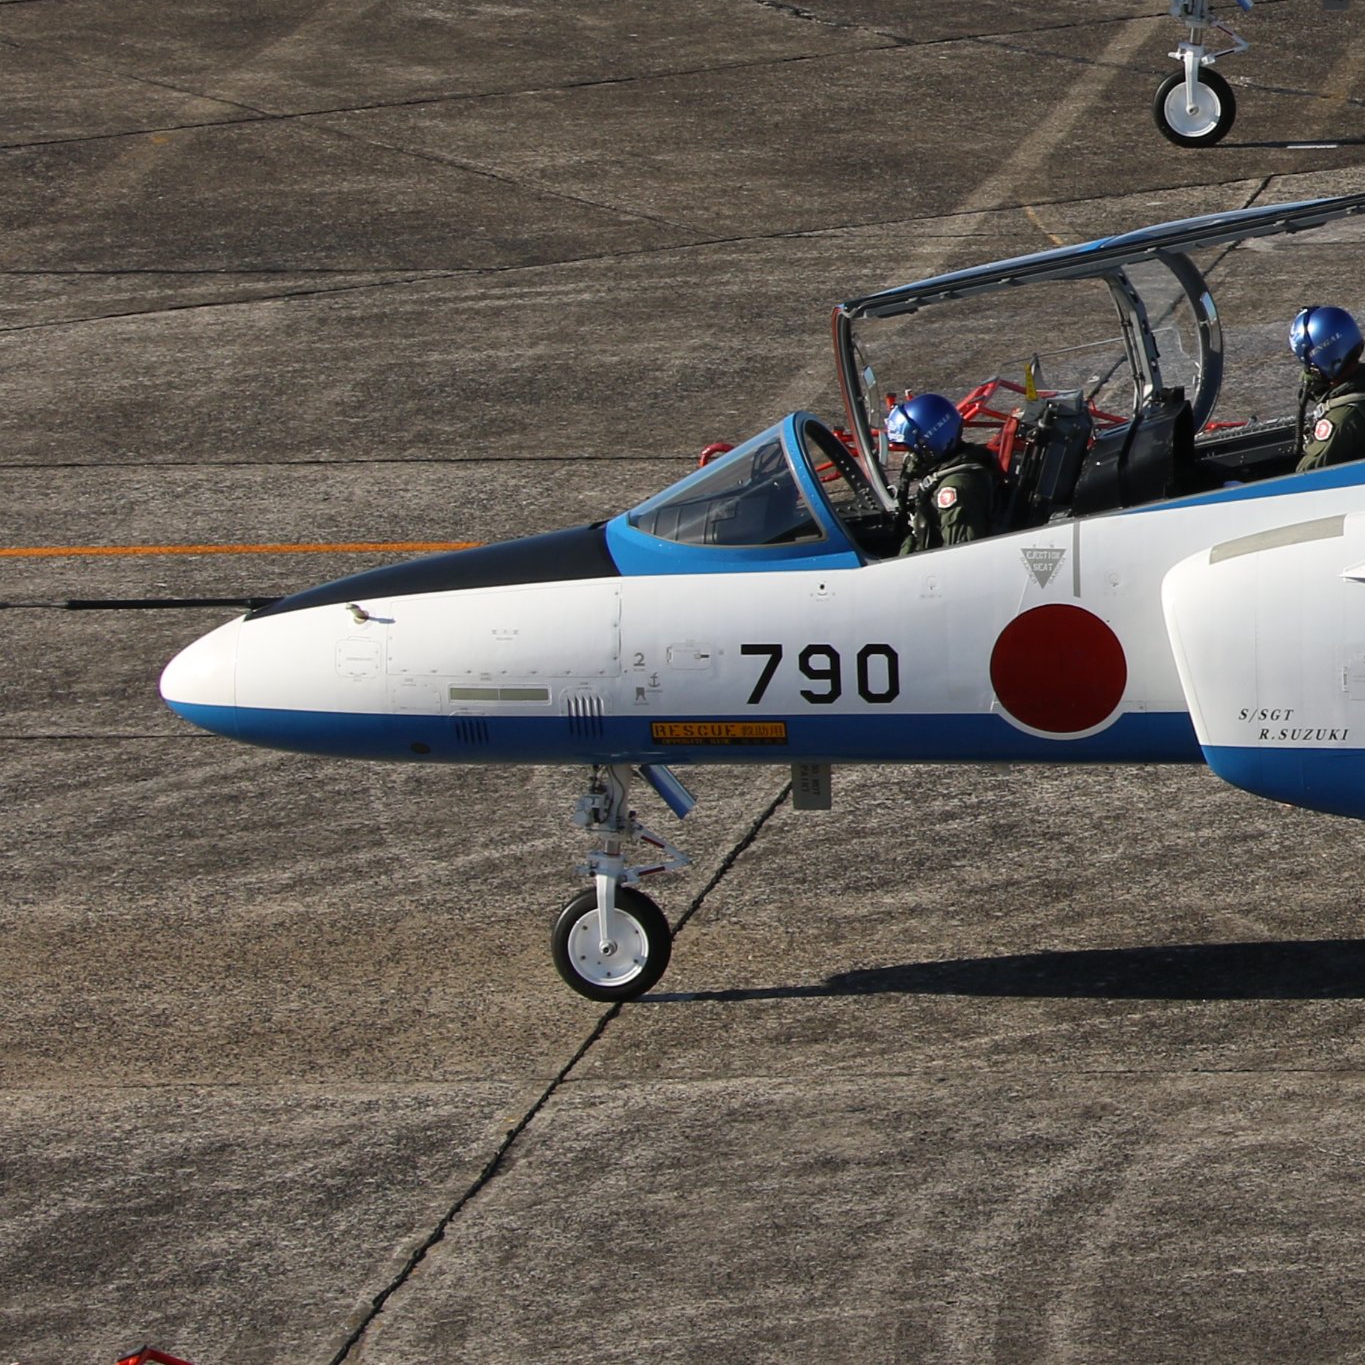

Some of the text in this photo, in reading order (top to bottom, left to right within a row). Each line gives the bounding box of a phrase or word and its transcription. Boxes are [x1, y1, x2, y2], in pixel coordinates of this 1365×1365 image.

[1026, 550, 1061, 560] EJECTION
[1032, 563, 1053, 572] SEAT
[633, 652, 645, 667] 2
[740, 643, 900, 704] 790
[1238, 707, 1294, 723] S/SGT
[654, 724, 737, 737] RESCUE
[1258, 728, 1350, 741] R.SUZUKI
